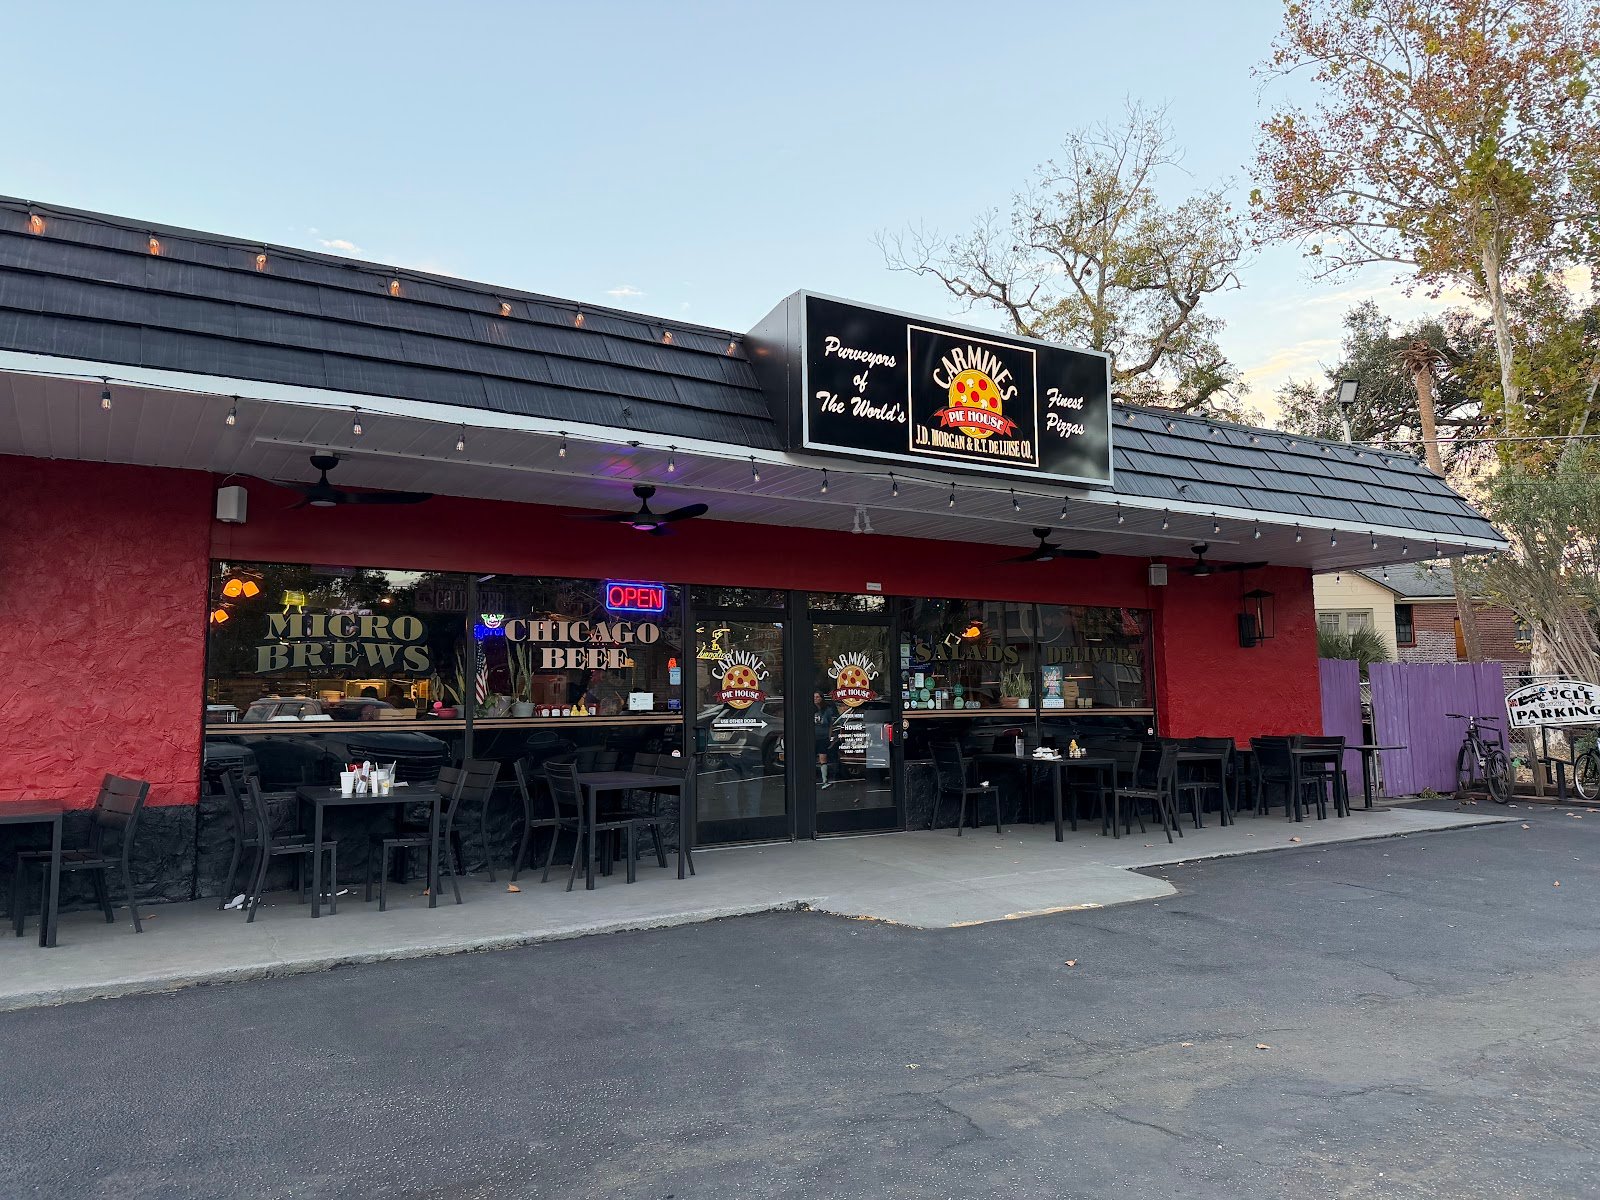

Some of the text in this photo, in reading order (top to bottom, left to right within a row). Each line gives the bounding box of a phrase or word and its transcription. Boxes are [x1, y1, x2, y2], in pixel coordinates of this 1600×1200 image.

[824, 335, 897, 368] Purveyors
[853, 371, 867, 393] of
[933, 345, 1018, 402] CARMINES
[815, 391, 906, 424] The World's
[1046, 388, 1083, 410] Finest
[948, 410, 1004, 430] PIE HOUSE
[1046, 412, 1085, 436] Pizzas
[916, 424, 930, 446] J.D.
[931, 427, 964, 450] MORGAN
[966, 436, 973, 450] &
[974, 435, 987, 452] R.T.
[999, 440, 1020, 458] LUISE
[1021, 439, 1033, 459] CO.
[609, 586, 663, 609] OPEN
[263, 613, 425, 643] MICRO
[504, 619, 660, 645] CHICAGO
[255, 641, 430, 674] BREWS
[539, 646, 629, 670] BEEF
[915, 642, 1020, 664] SALADS
[1046, 646, 1142, 665] DELIVERY
[711, 650, 770, 681] CARMINES
[827, 651, 879, 680] CARMINES
[722, 689, 760, 700] PIE HOUSE
[836, 689, 871, 700] PIE HOUSE
